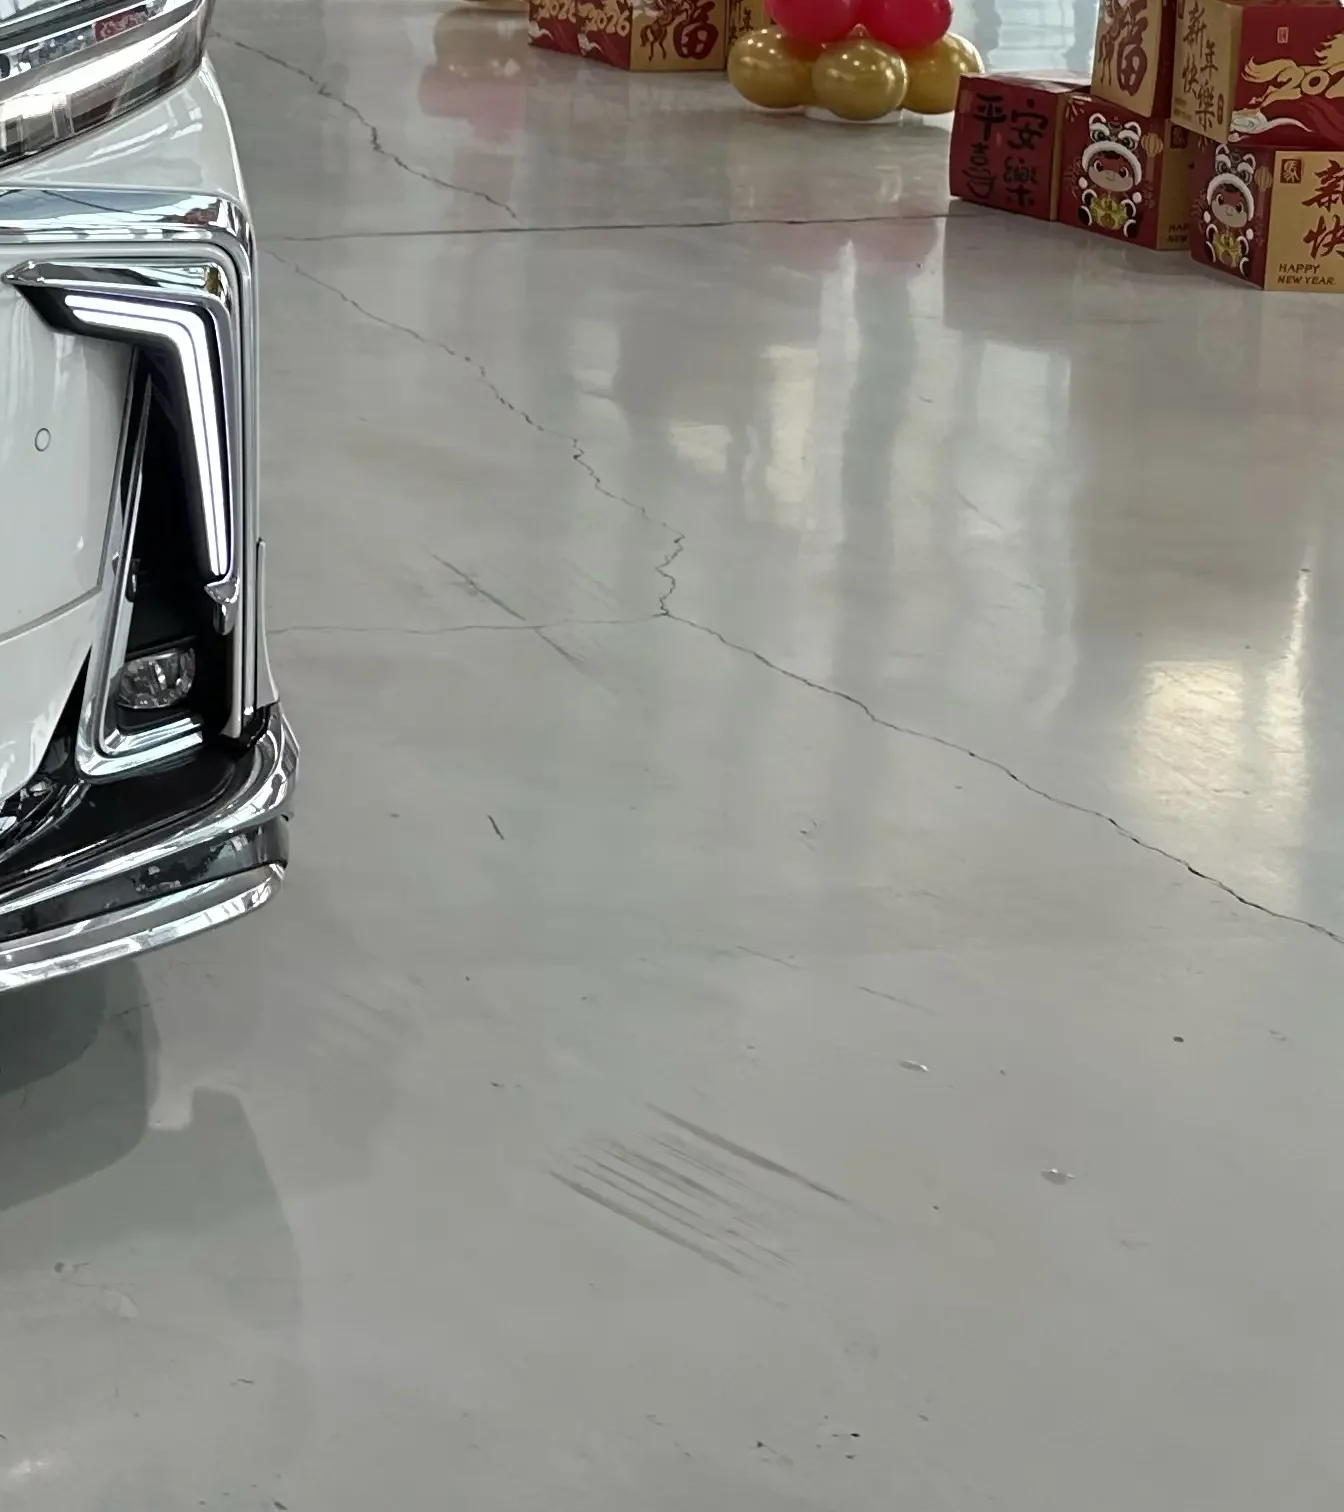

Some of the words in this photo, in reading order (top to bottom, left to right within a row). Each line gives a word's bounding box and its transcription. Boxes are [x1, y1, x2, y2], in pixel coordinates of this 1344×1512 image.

[586, 6, 632, 37] 2026
[1278, 263, 1320, 273] HAPPY
[1276, 274, 1304, 284] NEW
[1306, 274, 1336, 285] YEAR
